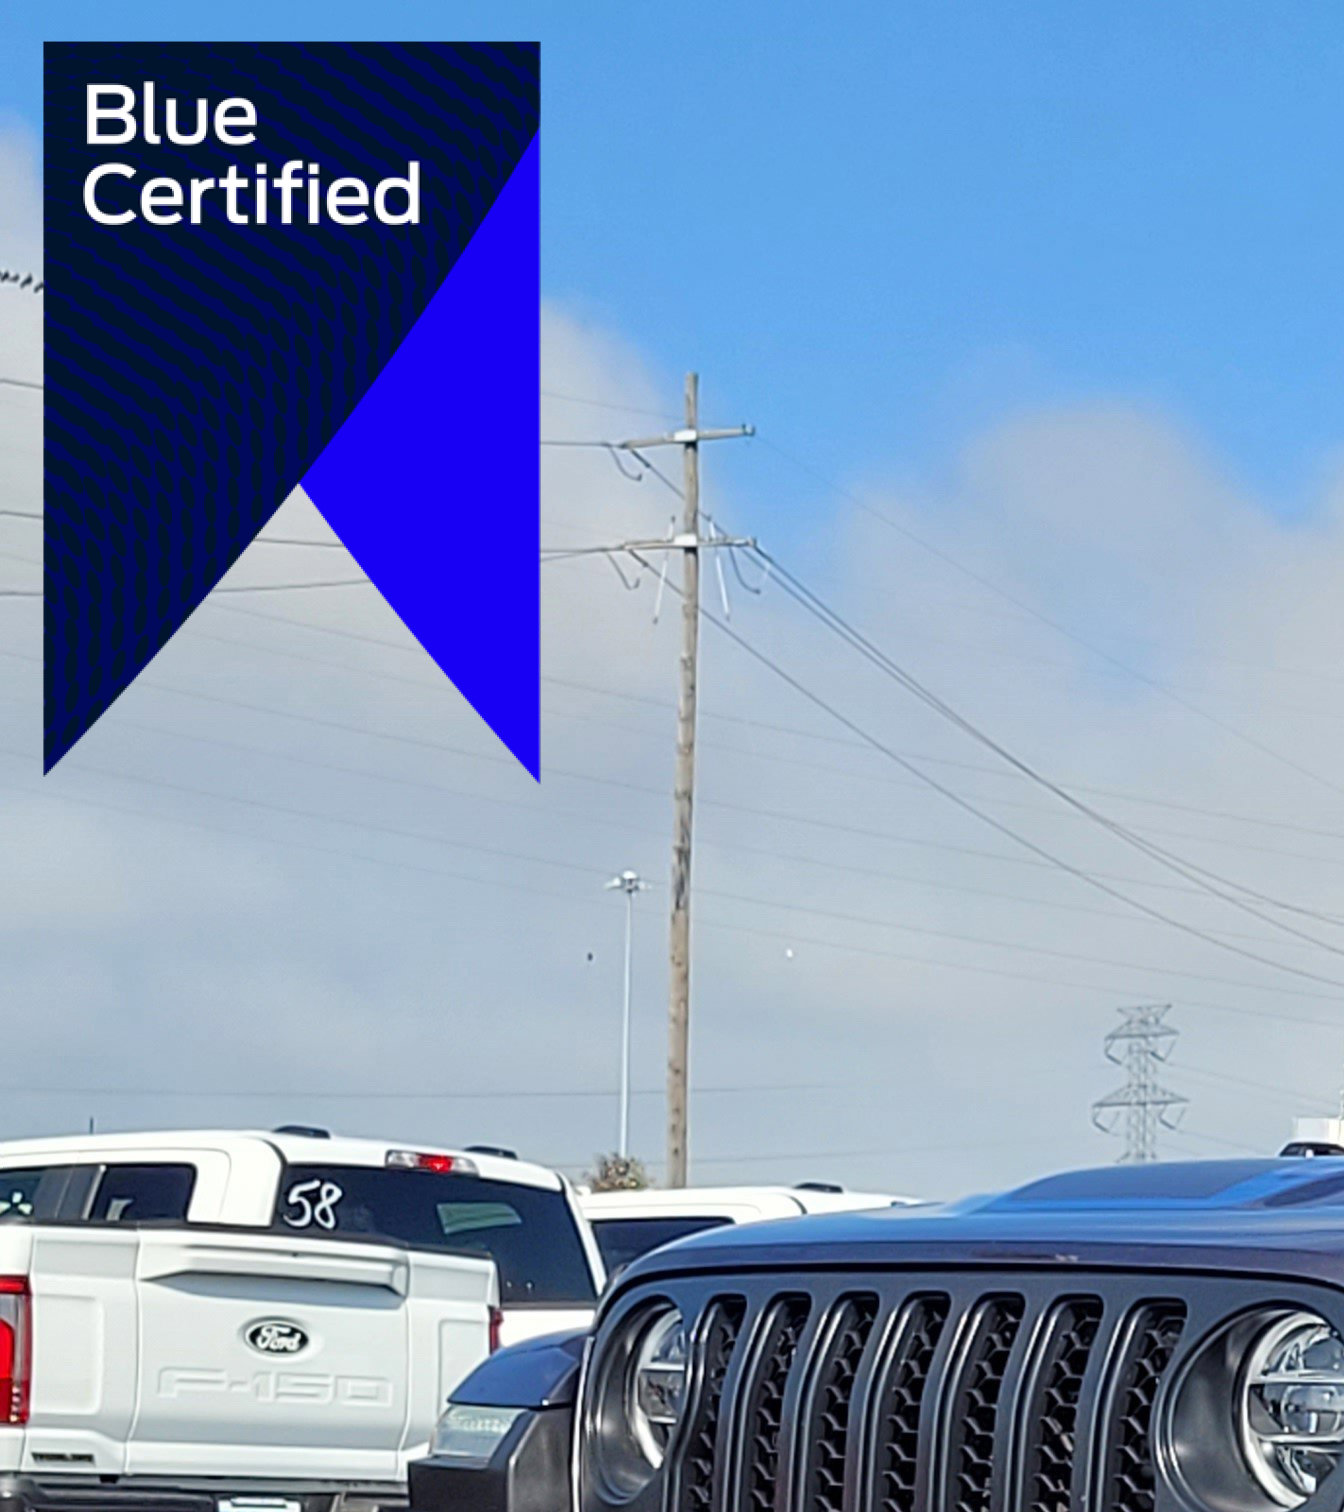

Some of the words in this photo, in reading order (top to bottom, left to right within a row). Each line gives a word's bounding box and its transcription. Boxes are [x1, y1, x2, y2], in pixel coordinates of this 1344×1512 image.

[283, 1179, 343, 1230] 58
[256, 1323, 301, 1351] Ford
[157, 1367, 394, 1408] F-150
